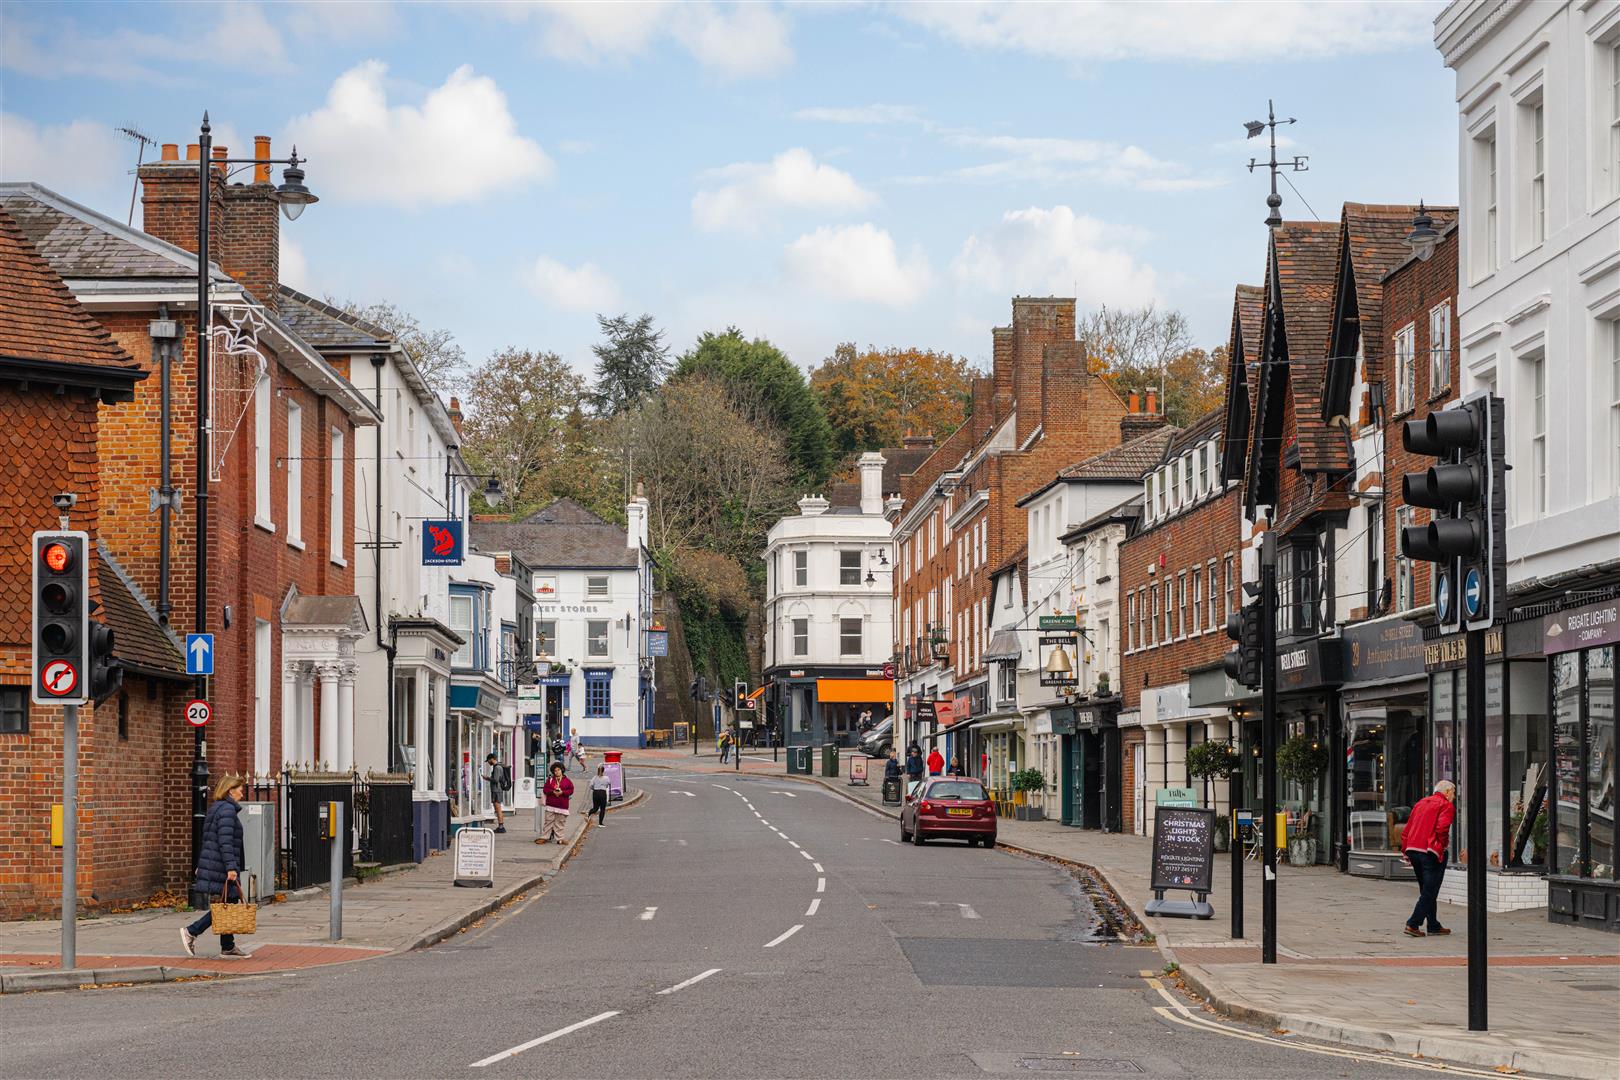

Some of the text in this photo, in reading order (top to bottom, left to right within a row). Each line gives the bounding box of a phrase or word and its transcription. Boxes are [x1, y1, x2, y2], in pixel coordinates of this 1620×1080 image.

[560, 605, 598, 613] STORES
[1568, 607, 1617, 631] REIGATE LIGHTING
[1581, 628, 1603, 641] COMPANY
[1424, 643, 1439, 665] THE
[1440, 640, 1457, 662] TILE
[1367, 647, 1393, 670] Antiques
[189, 708, 208, 719] 20
[1163, 820, 1206, 829] CHRISTMAS
[1171, 828, 1197, 836] LIGHTS
[1177, 835, 1200, 843] STOCK
[1181, 855, 1205, 863] LIGHTING
